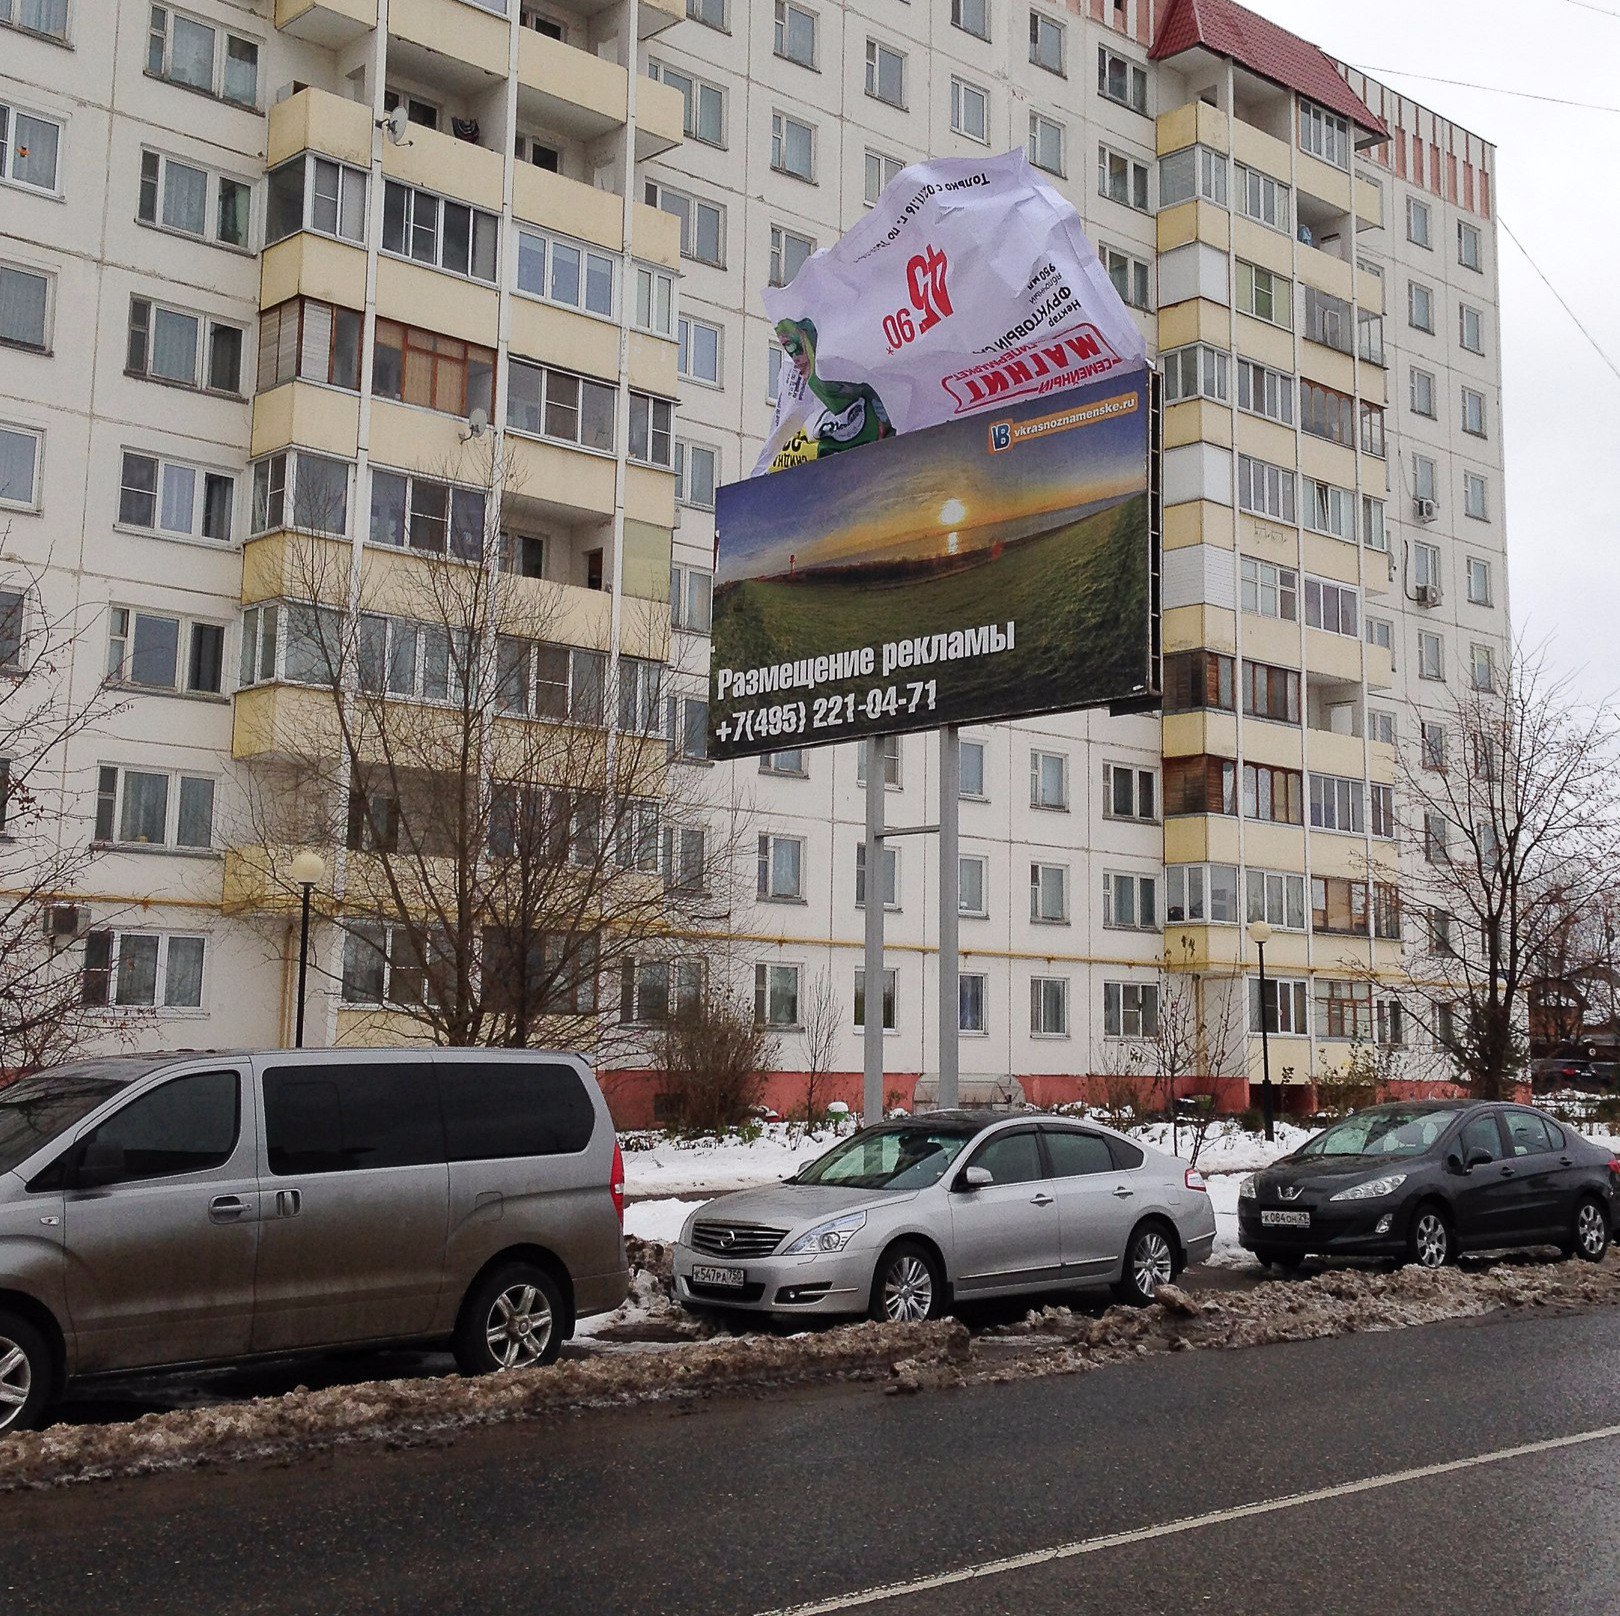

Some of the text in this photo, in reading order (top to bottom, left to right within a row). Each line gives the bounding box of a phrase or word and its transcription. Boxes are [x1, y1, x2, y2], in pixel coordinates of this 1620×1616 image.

[944, 173, 991, 192] Только
[906, 244, 954, 334] 45
[1027, 262, 1057, 291] 950 мл
[1048, 299, 1083, 328] Нектар
[964, 333, 1102, 404] МАГНИТ
[1037, 357, 1114, 395] СЕМЕЙНЫЙ
[1014, 397, 1135, 437] vkrasnoznamenske.ru
[716, 621, 1015, 700] Размещение рекламы
[715, 679, 937, 742] +7(495) 221-04-71
